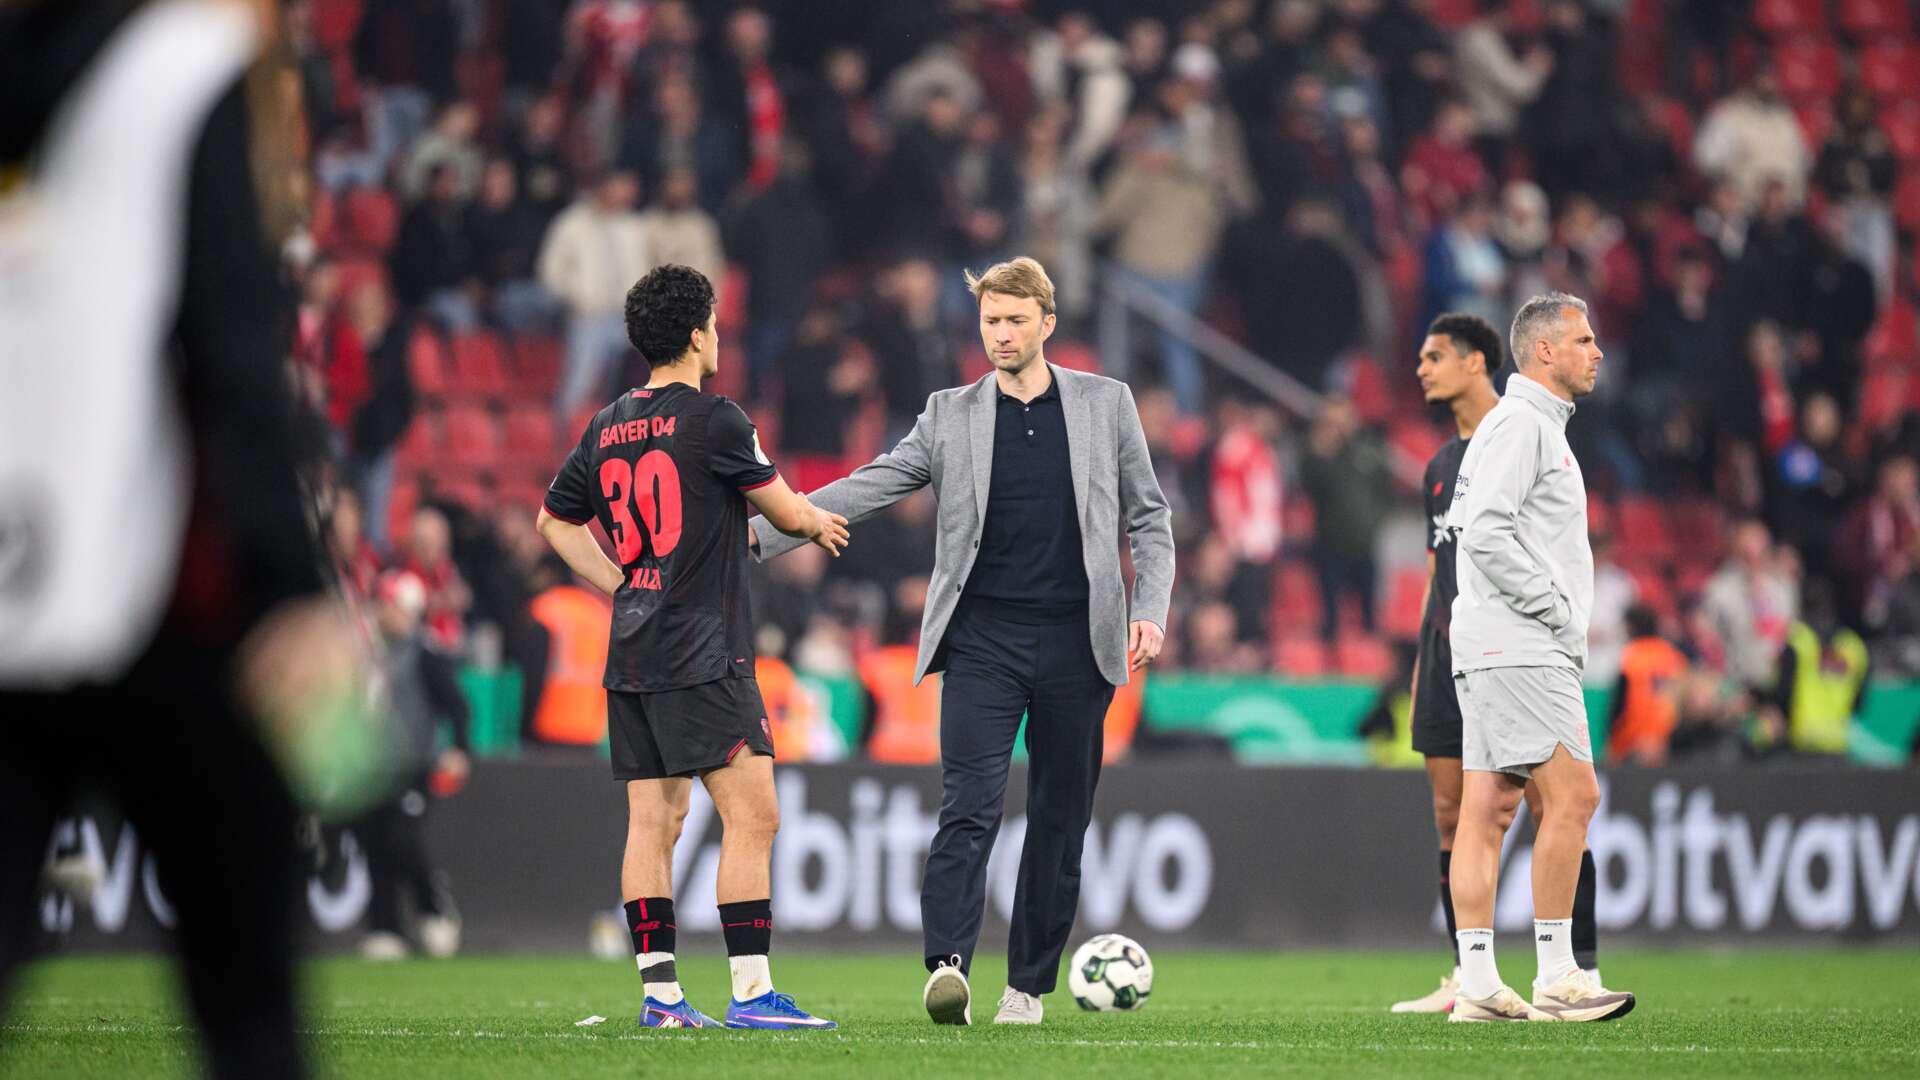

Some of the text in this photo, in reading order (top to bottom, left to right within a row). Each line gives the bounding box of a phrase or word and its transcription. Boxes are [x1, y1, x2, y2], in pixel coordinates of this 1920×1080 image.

[599, 415, 676, 449] BAYER 04
[599, 449, 682, 565] 30
[1585, 774, 1920, 932] bitvav
